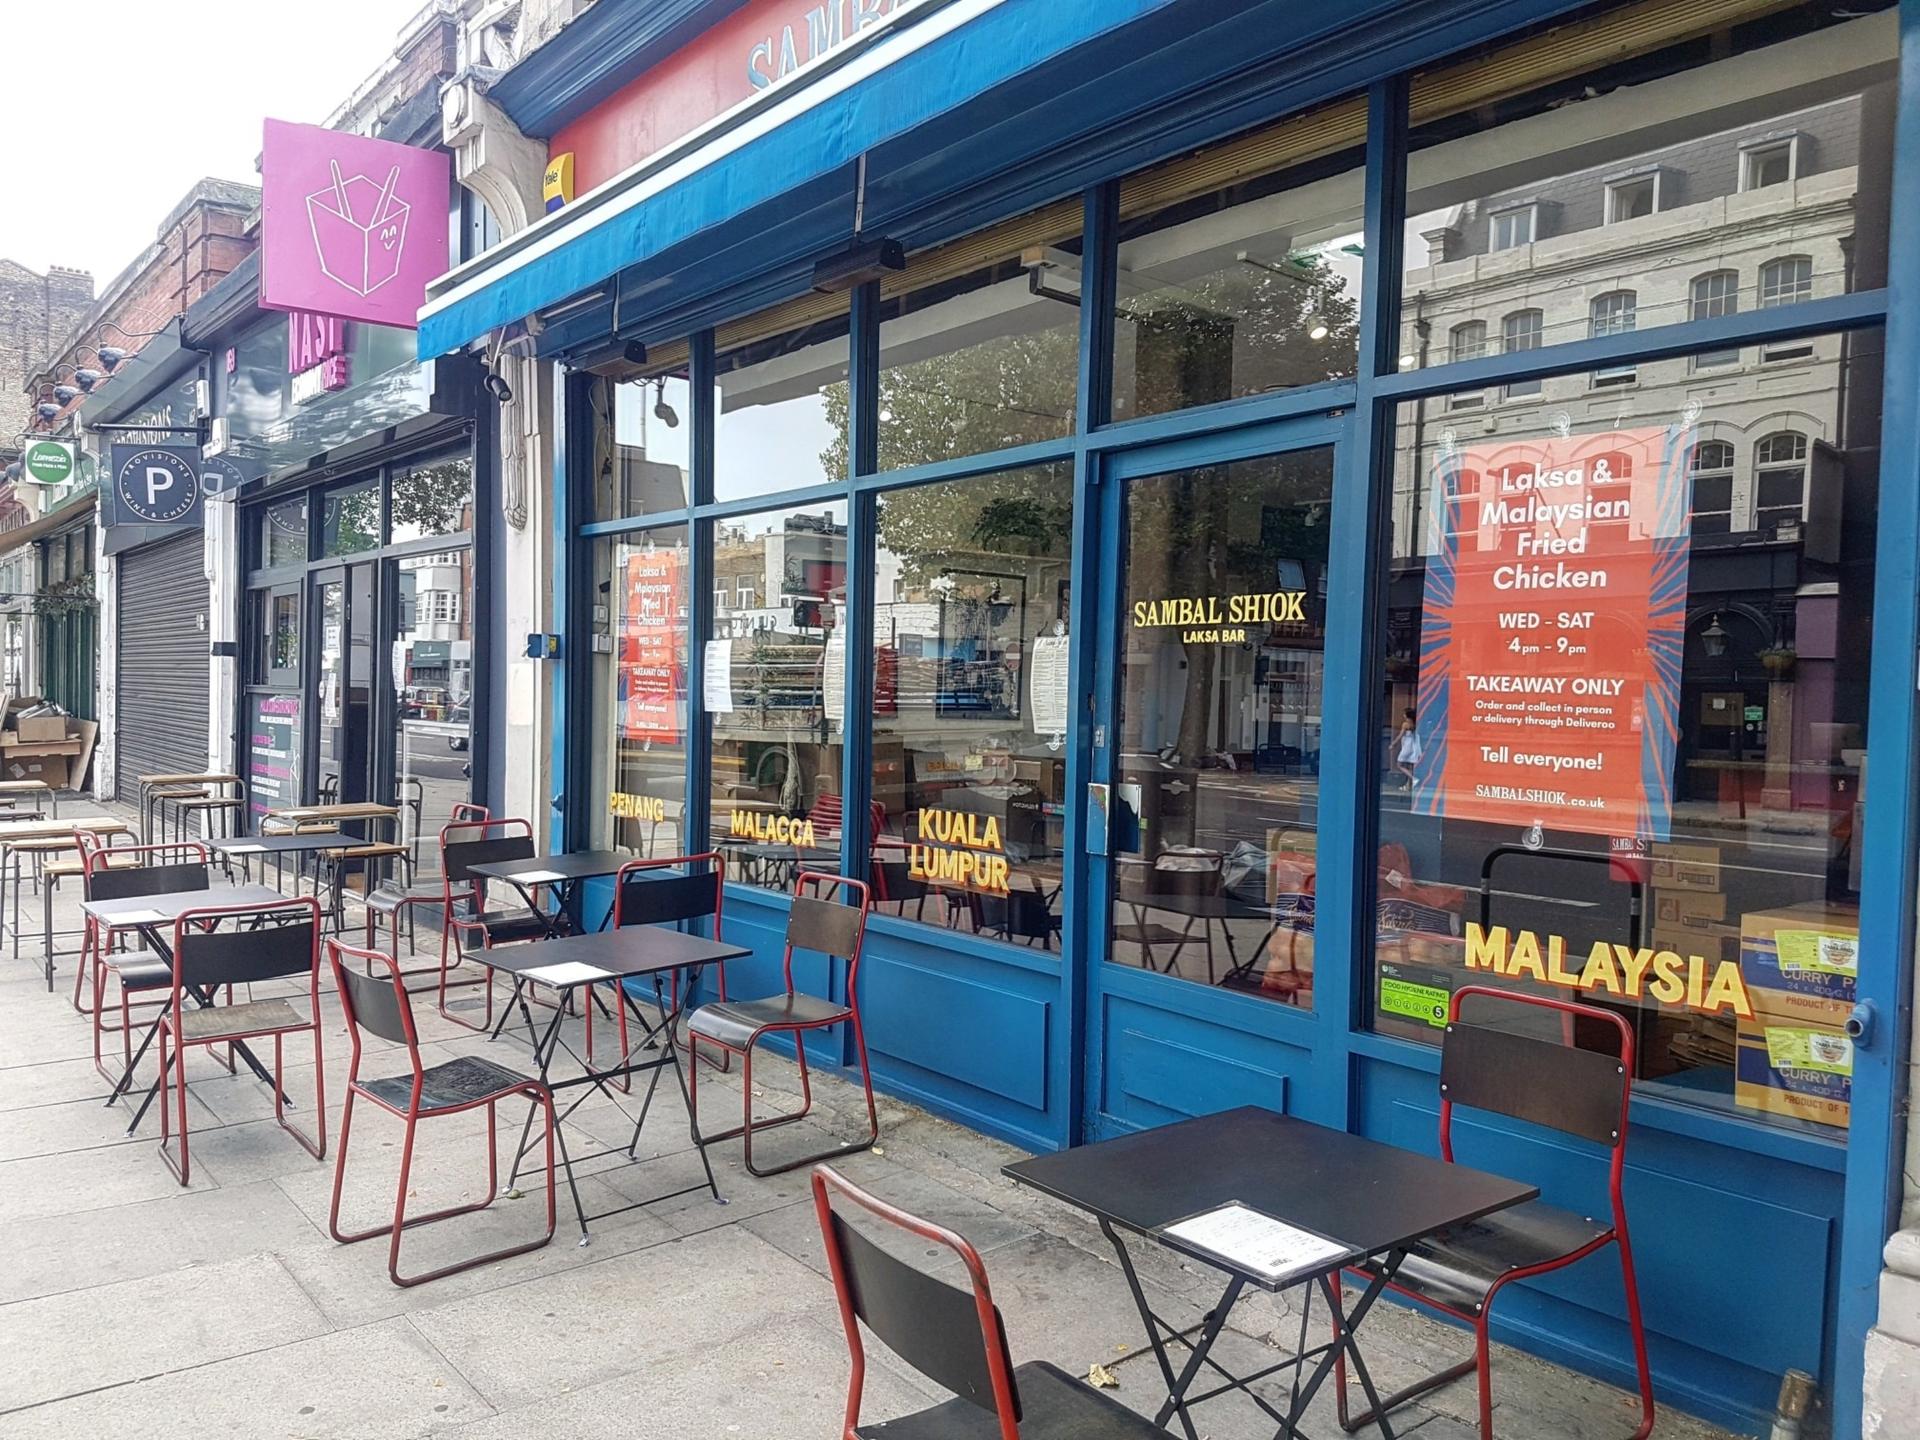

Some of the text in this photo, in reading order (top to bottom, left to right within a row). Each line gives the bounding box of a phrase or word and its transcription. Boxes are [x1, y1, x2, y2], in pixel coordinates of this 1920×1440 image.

[747, 0, 901, 90] SAMB
[123, 453, 190, 478] PROVISIONS
[1502, 458, 1614, 491] Laksa &
[146, 467, 174, 505] P
[124, 491, 147, 514] WINE
[162, 491, 193, 519] CHEESE
[1481, 495, 1630, 528] Malaysian
[1517, 527, 1587, 556] Fried
[1493, 561, 1607, 589] Chicken
[1134, 591, 1307, 628] SAMBAL SHIOK
[1499, 613, 1540, 629] WED
[1557, 612, 1594, 628] SAT
[1183, 629, 1245, 643] LAKSA BAR
[1508, 636, 1539, 655] 4pm
[1556, 636, 1586, 656] 9pm
[1466, 675, 1625, 696] TAKEAWAY ONLY
[1471, 713, 1616, 730] or delivery through Deliveroo
[1475, 700, 1612, 717] Order and collect in person
[1480, 746, 1603, 772] Tell everyone!
[609, 792, 664, 822] PENANG
[730, 809, 817, 848] MALACCA
[918, 808, 1002, 851] KUALA
[909, 843, 1011, 893] LUMPUR
[1464, 921, 1756, 1020] MALAYSIA
[1782, 969, 1832, 985] CURRY
[1384, 981, 1446, 999] FOOD HYGIENE RATING
[1786, 996, 1824, 1010] PRODUCT
[1435, 1006, 1442, 1017] 5
[1779, 1067, 1831, 1085] CURRY
[1783, 1094, 1823, 1110] PRODUCT
